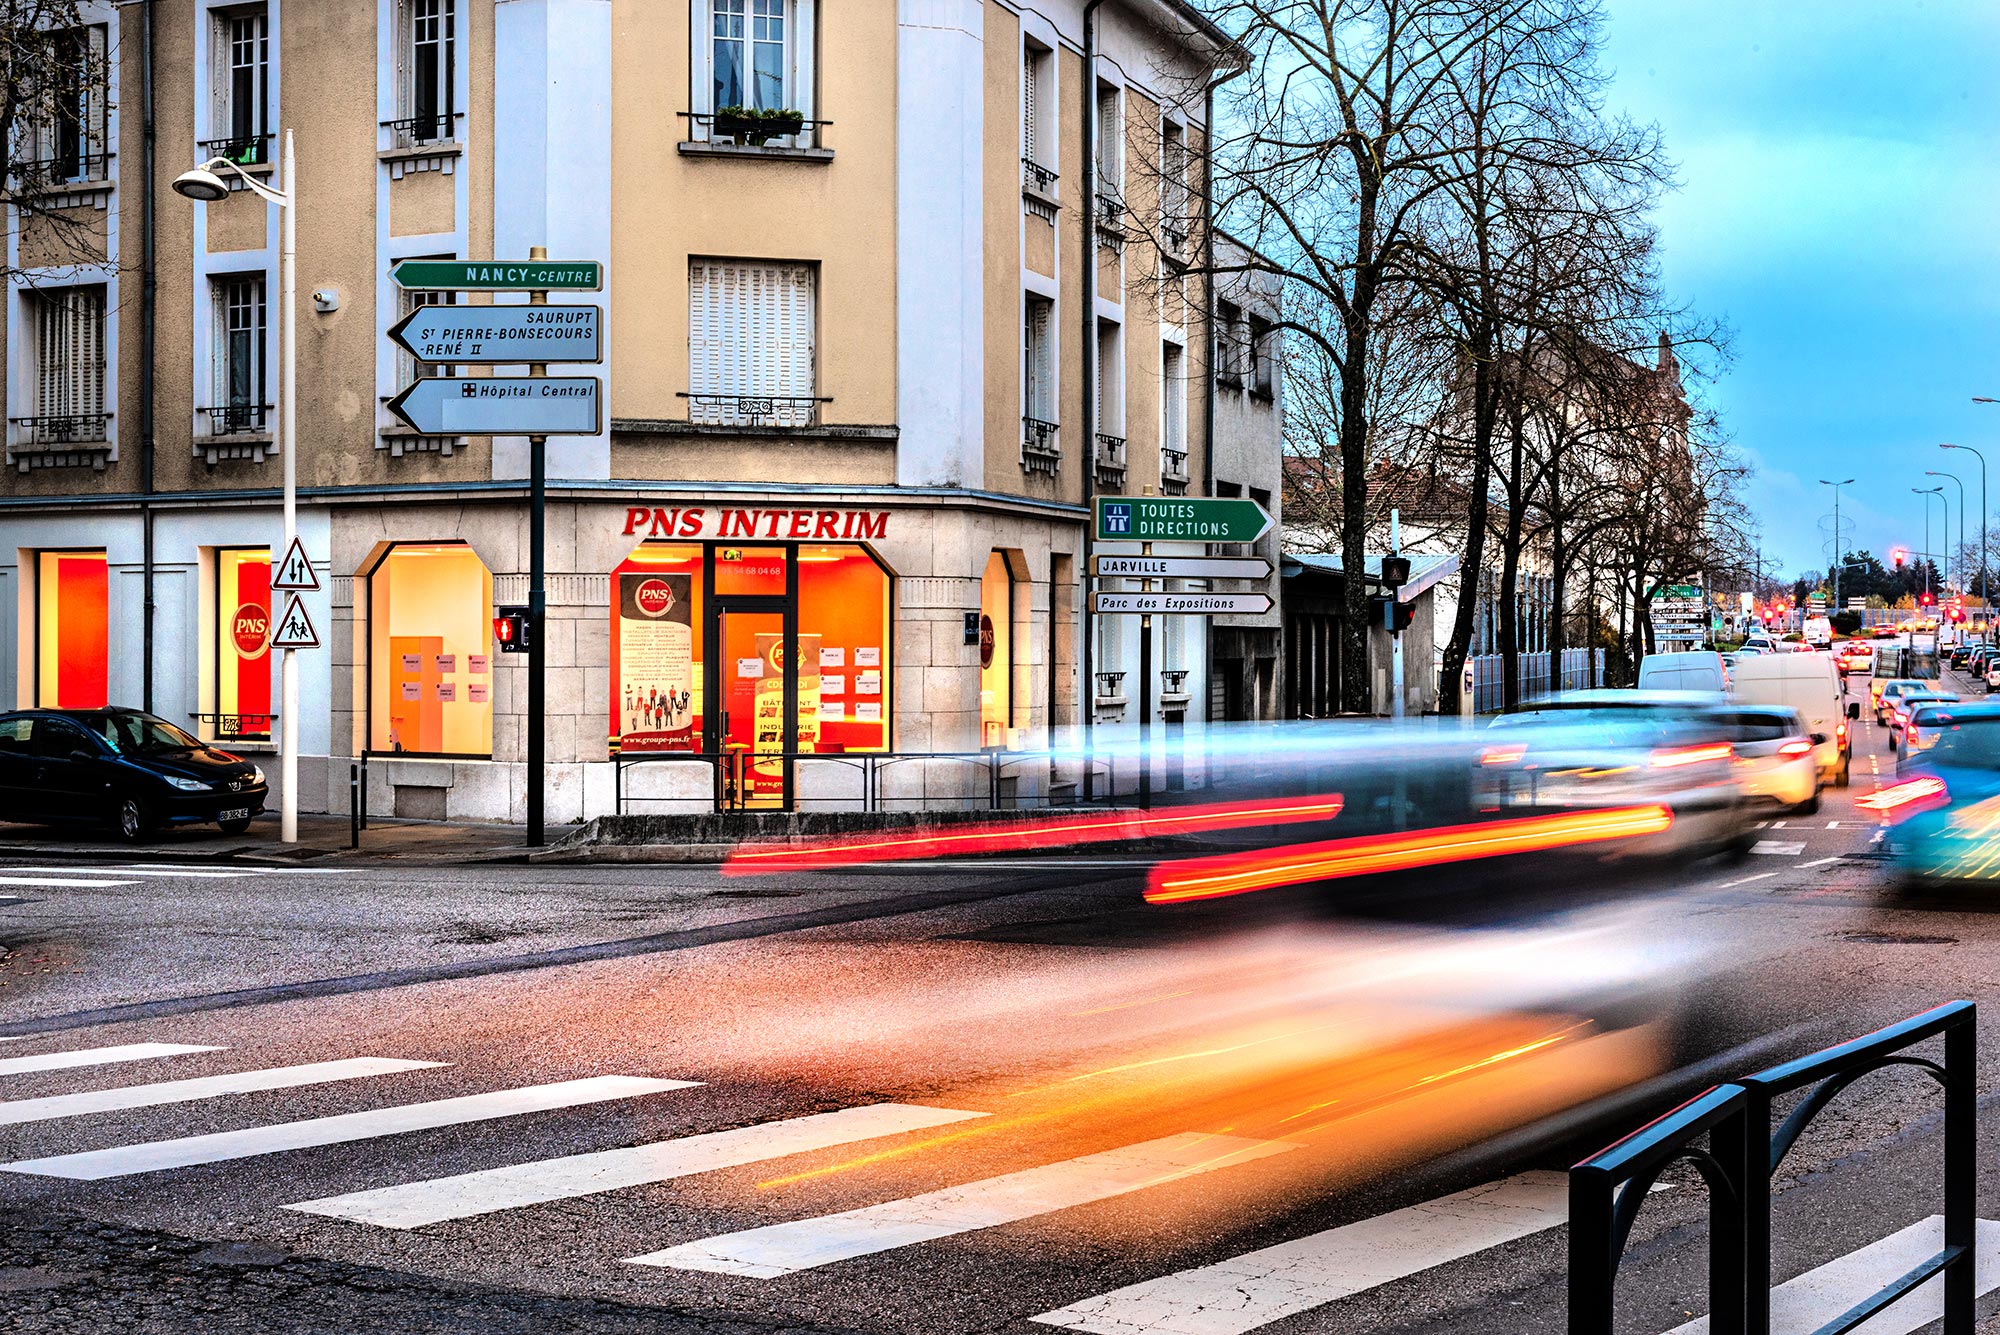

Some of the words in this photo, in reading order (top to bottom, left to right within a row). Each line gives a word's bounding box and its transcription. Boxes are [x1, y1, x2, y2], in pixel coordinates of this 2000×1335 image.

[466, 267, 593, 282] NANCY-CENTRE
[526, 312, 592, 324] SAURUPT
[442, 328, 593, 339] PIERRE-BONSECOURS
[420, 342, 462, 355] -RENÉ
[470, 344, 482, 355] II
[480, 385, 532, 399] Hôpital
[542, 386, 593, 396] Central
[1141, 504, 1194, 518] TOUTES
[622, 507, 704, 537] PNS
[716, 509, 891, 539] INTERIM
[1140, 522, 1229, 535] DIRECTIONS
[1103, 562, 1167, 572] JARVILLE
[641, 590, 668, 599] PNS
[1102, 598, 1128, 608] Parc
[1137, 598, 1157, 608] des
[1165, 598, 1234, 611] Expositions
[236, 619, 265, 633] PNS
